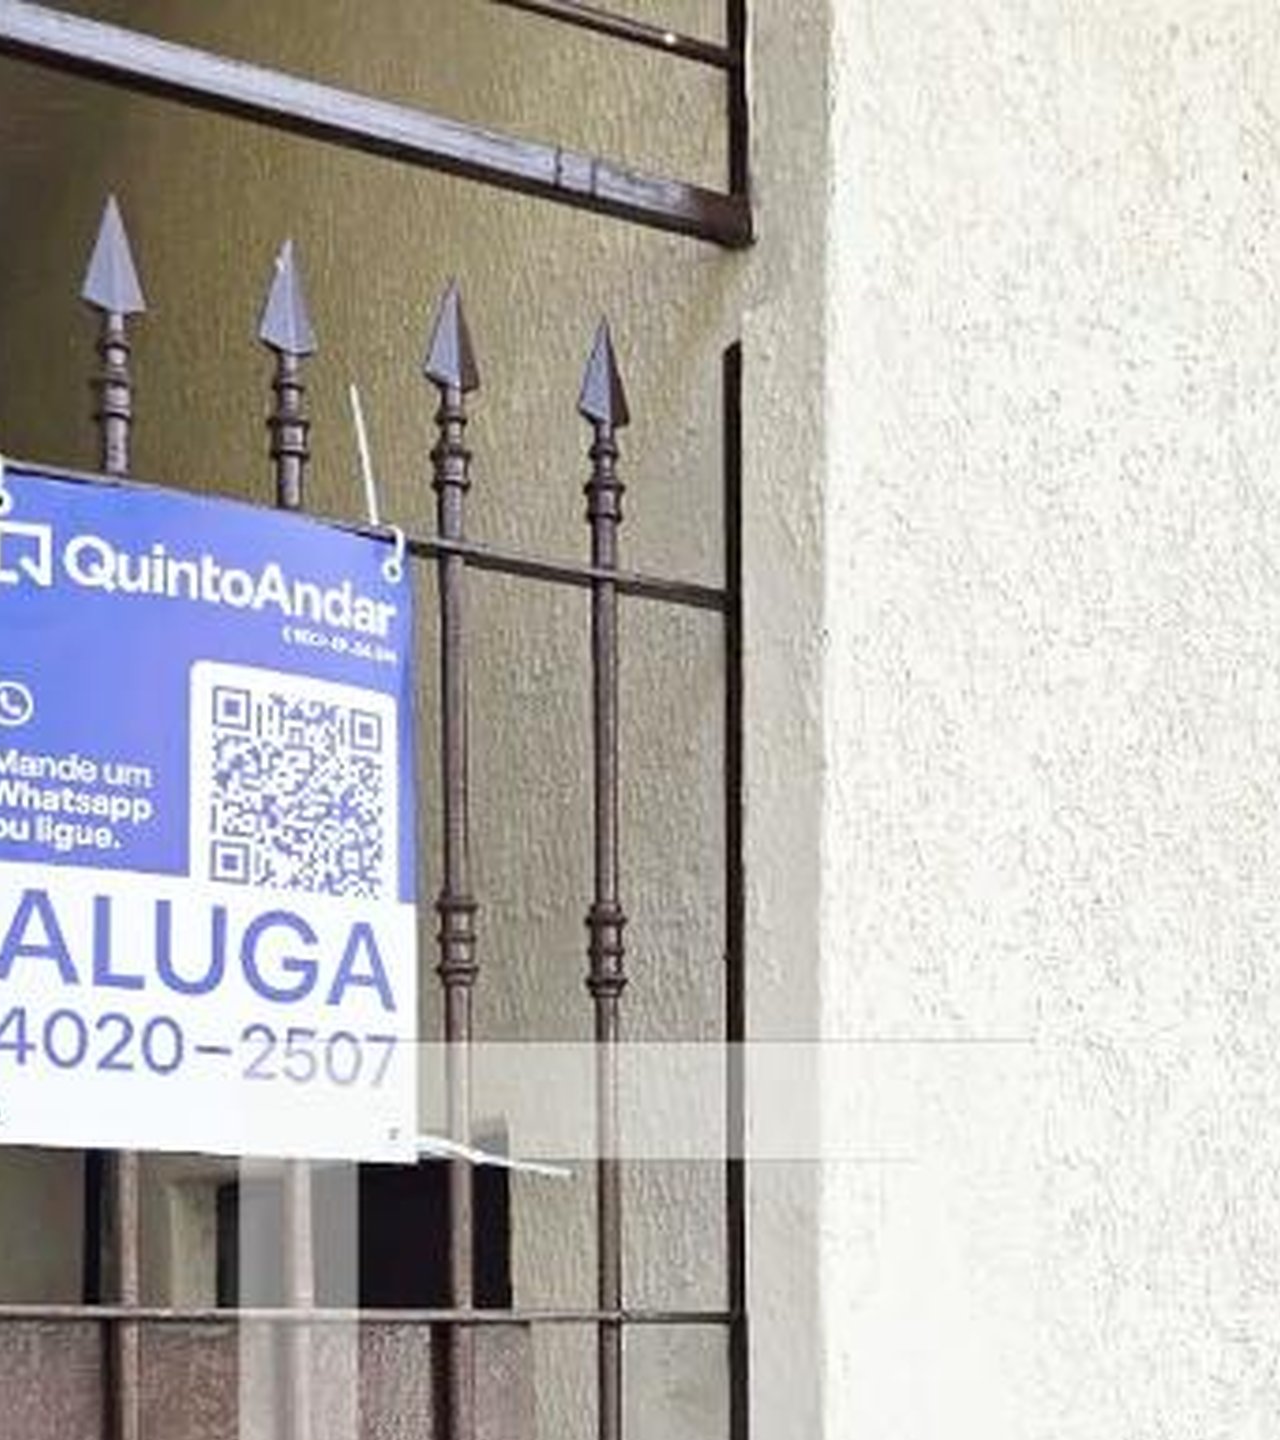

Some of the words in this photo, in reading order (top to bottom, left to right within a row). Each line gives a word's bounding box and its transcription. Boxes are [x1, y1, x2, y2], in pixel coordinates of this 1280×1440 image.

[63, 534, 397, 637] QuintoAndar
[103, 762, 153, 790] um
[35, 814, 121, 851] ligue.
